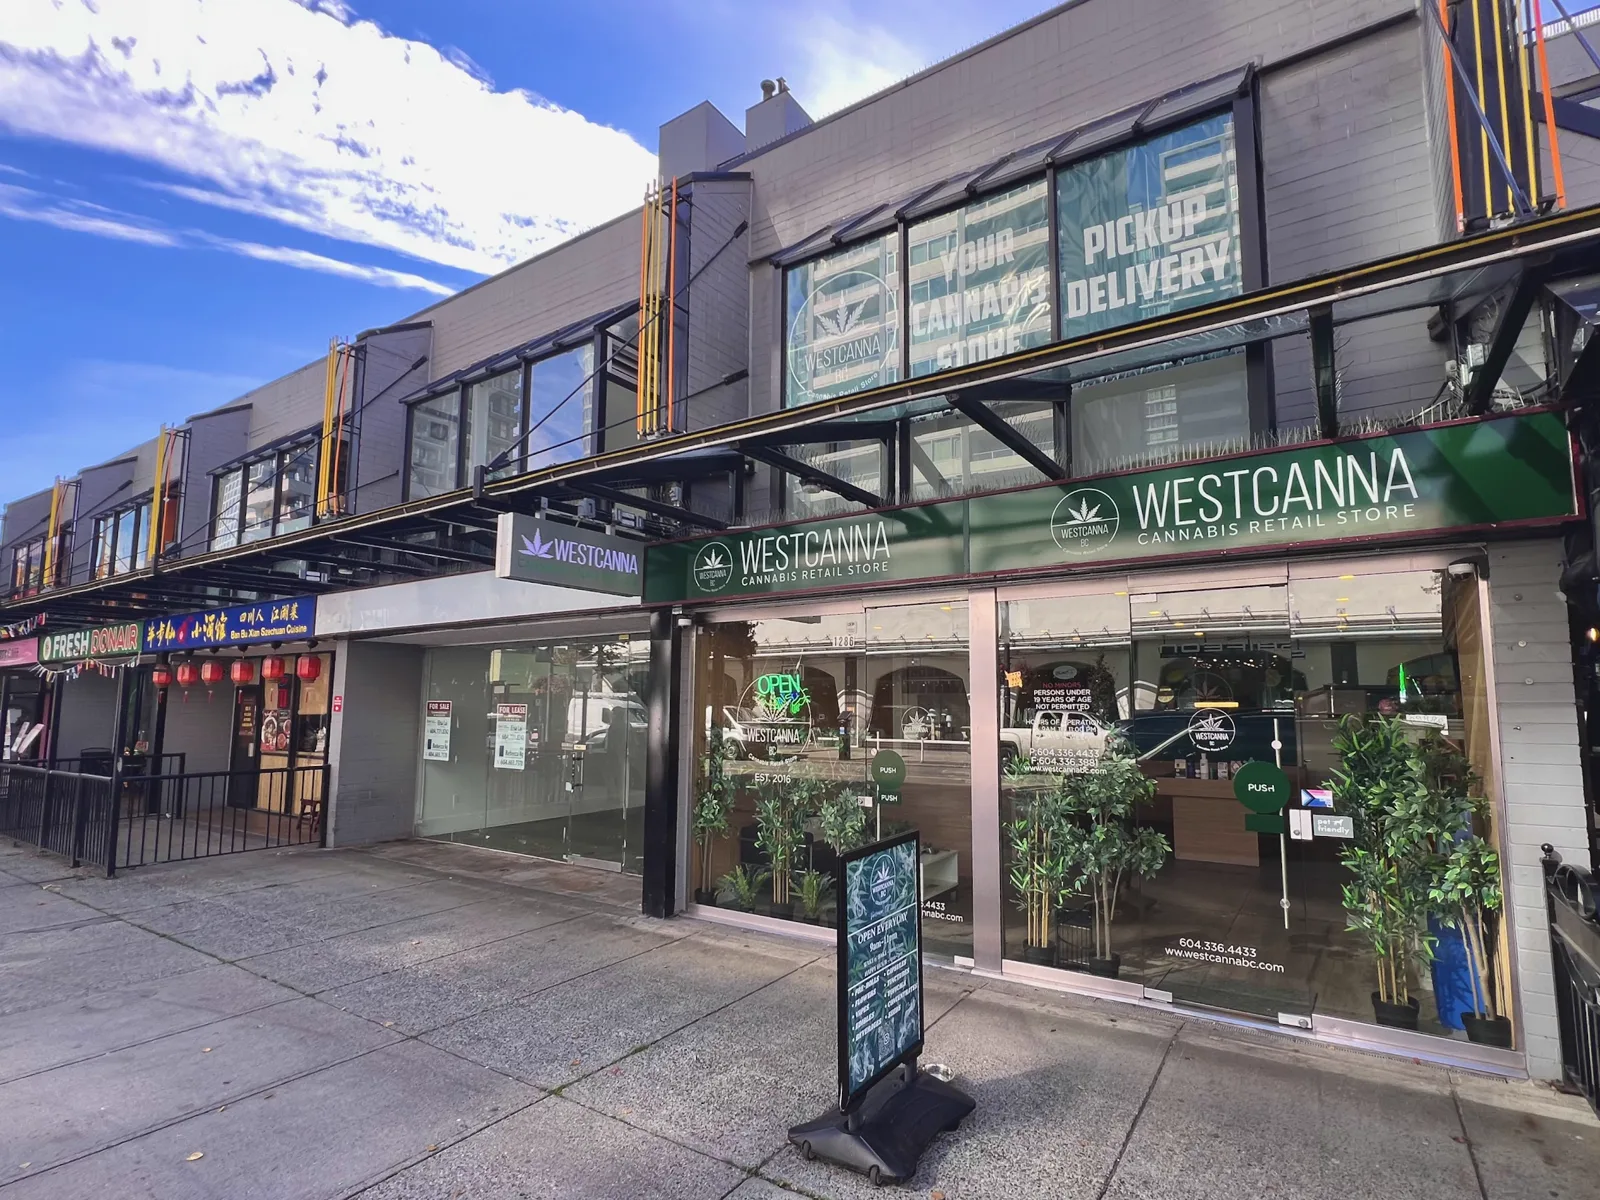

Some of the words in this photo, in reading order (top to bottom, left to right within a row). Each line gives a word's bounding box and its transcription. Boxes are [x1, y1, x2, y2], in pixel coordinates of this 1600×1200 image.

[1083, 194, 1206, 265] PICKUP
[940, 228, 1015, 283] YOUR
[1067, 237, 1230, 318] DELIVERY
[911, 266, 1047, 336] CANNABIS
[804, 335, 881, 371] WESTCANNA
[936, 325, 1021, 368] STORE
[835, 365, 848, 383] BC
[861, 372, 878, 389] Store
[1132, 447, 1418, 530] WESTCANNA
[1061, 524, 1109, 539] WESTCANNA
[1137, 523, 1238, 545] CANNABIS
[1250, 514, 1325, 533] RETAIL
[1337, 503, 1416, 524] STORE
[740, 521, 891, 575] WESTCANNA
[1080, 538, 1089, 547] BC
[554, 538, 638, 575] WESTCANNA
[699, 569, 727, 580] WESTCANNA
[741, 572, 797, 586] CANNABIS
[802, 566, 842, 580] RETAIL
[848, 561, 889, 575] STORE
[53, 631, 90, 658] FRESH
[91, 623, 138, 655] DONAIR
[230, 630, 240, 640] Ban
[241, 629, 248, 638] Bu
[248, 628, 260, 638] Xian
[260, 626, 285, 637] Szechuan
[286, 624, 307, 634] Cuisine
[833, 636, 854, 647] 1286
[758, 673, 800, 694] OPEN
[747, 728, 800, 743] WESTCANNA
[1194, 732, 1229, 741] WESTCANNA
[768, 746, 777, 755] BC
[1029, 748, 1100, 758] P:604.336.4433
[754, 772, 771, 782] EST.
[772, 774, 791, 784] 2016
[879, 766, 897, 774] PUSH
[1023, 765, 1107, 775] www.westcannabc.com
[1247, 783, 1275, 793] PUSH
[880, 794, 898, 802] PUSH
[1317, 825, 1350, 835] friendly
[857, 927, 877, 944] OPEN
[876, 911, 908, 935] EVERYDAY
[1179, 937, 1257, 958] 604.336.4433
[1164, 947, 1285, 973] ww.westcannabc.com
